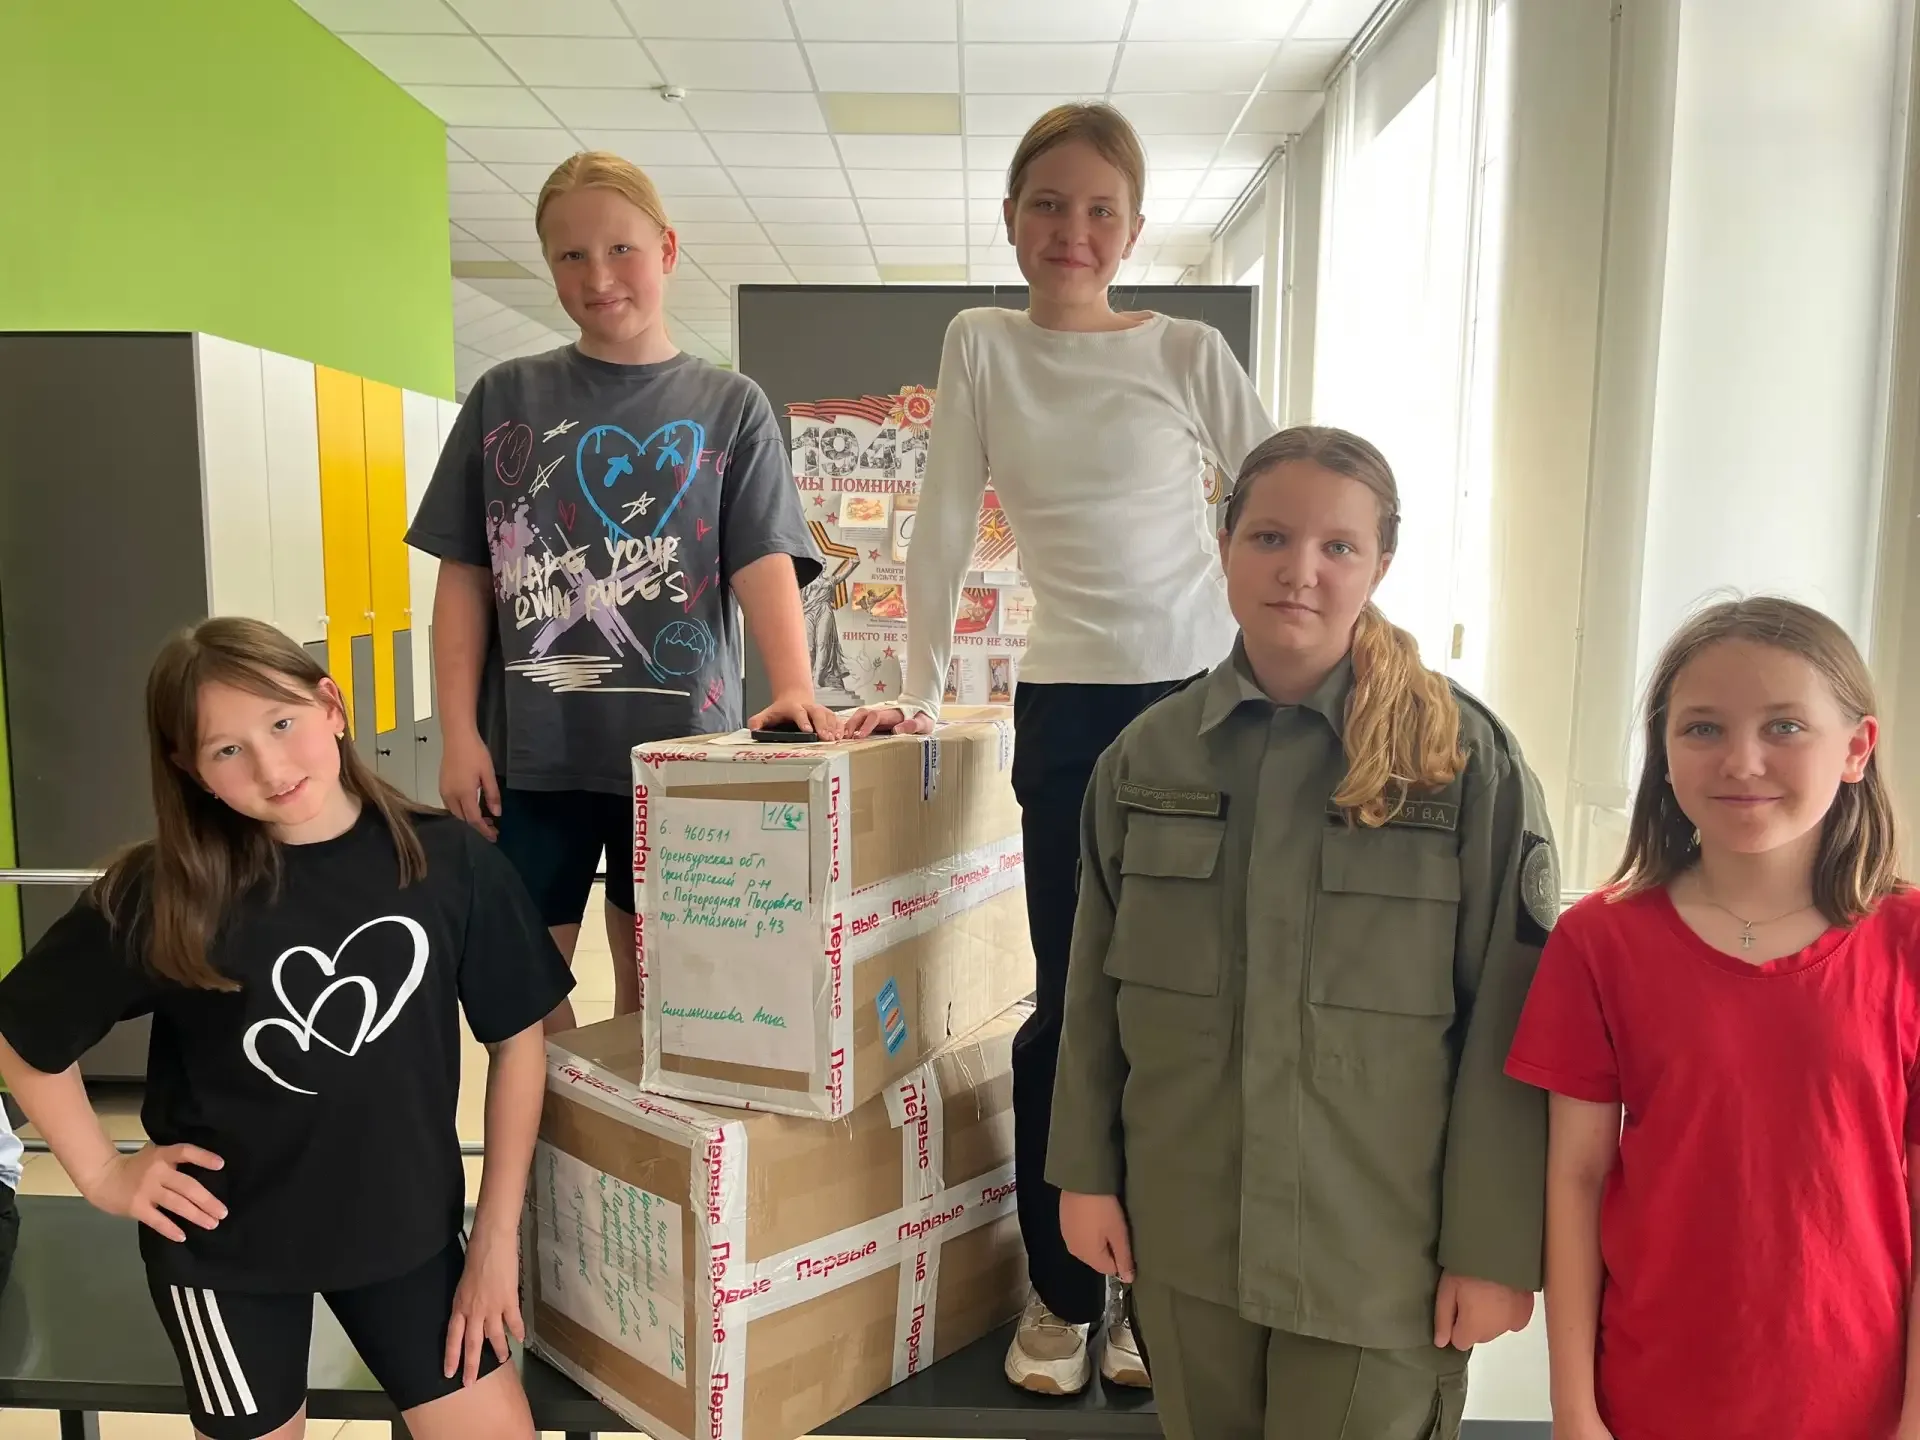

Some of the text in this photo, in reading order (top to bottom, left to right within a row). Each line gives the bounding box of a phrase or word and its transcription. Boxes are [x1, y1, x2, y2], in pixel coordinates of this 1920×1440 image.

[792, 426, 929, 479] 1941
[794, 477, 824, 491] МЫ
[502, 536, 682, 589] MAKE YOUR
[515, 571, 689, 630] OWN RULES
[842, 631, 880, 641] НИКТО
[884, 633, 898, 642] НЕ
[986, 637, 1002, 646] НЕ
[684, 824, 731, 843] 460511
[892, 888, 940, 920] Первые
[824, 911, 844, 1019] Первые
[702, 1127, 726, 1226] Первые
[796, 1240, 878, 1281] Первые
[898, 1203, 965, 1241] Первые
